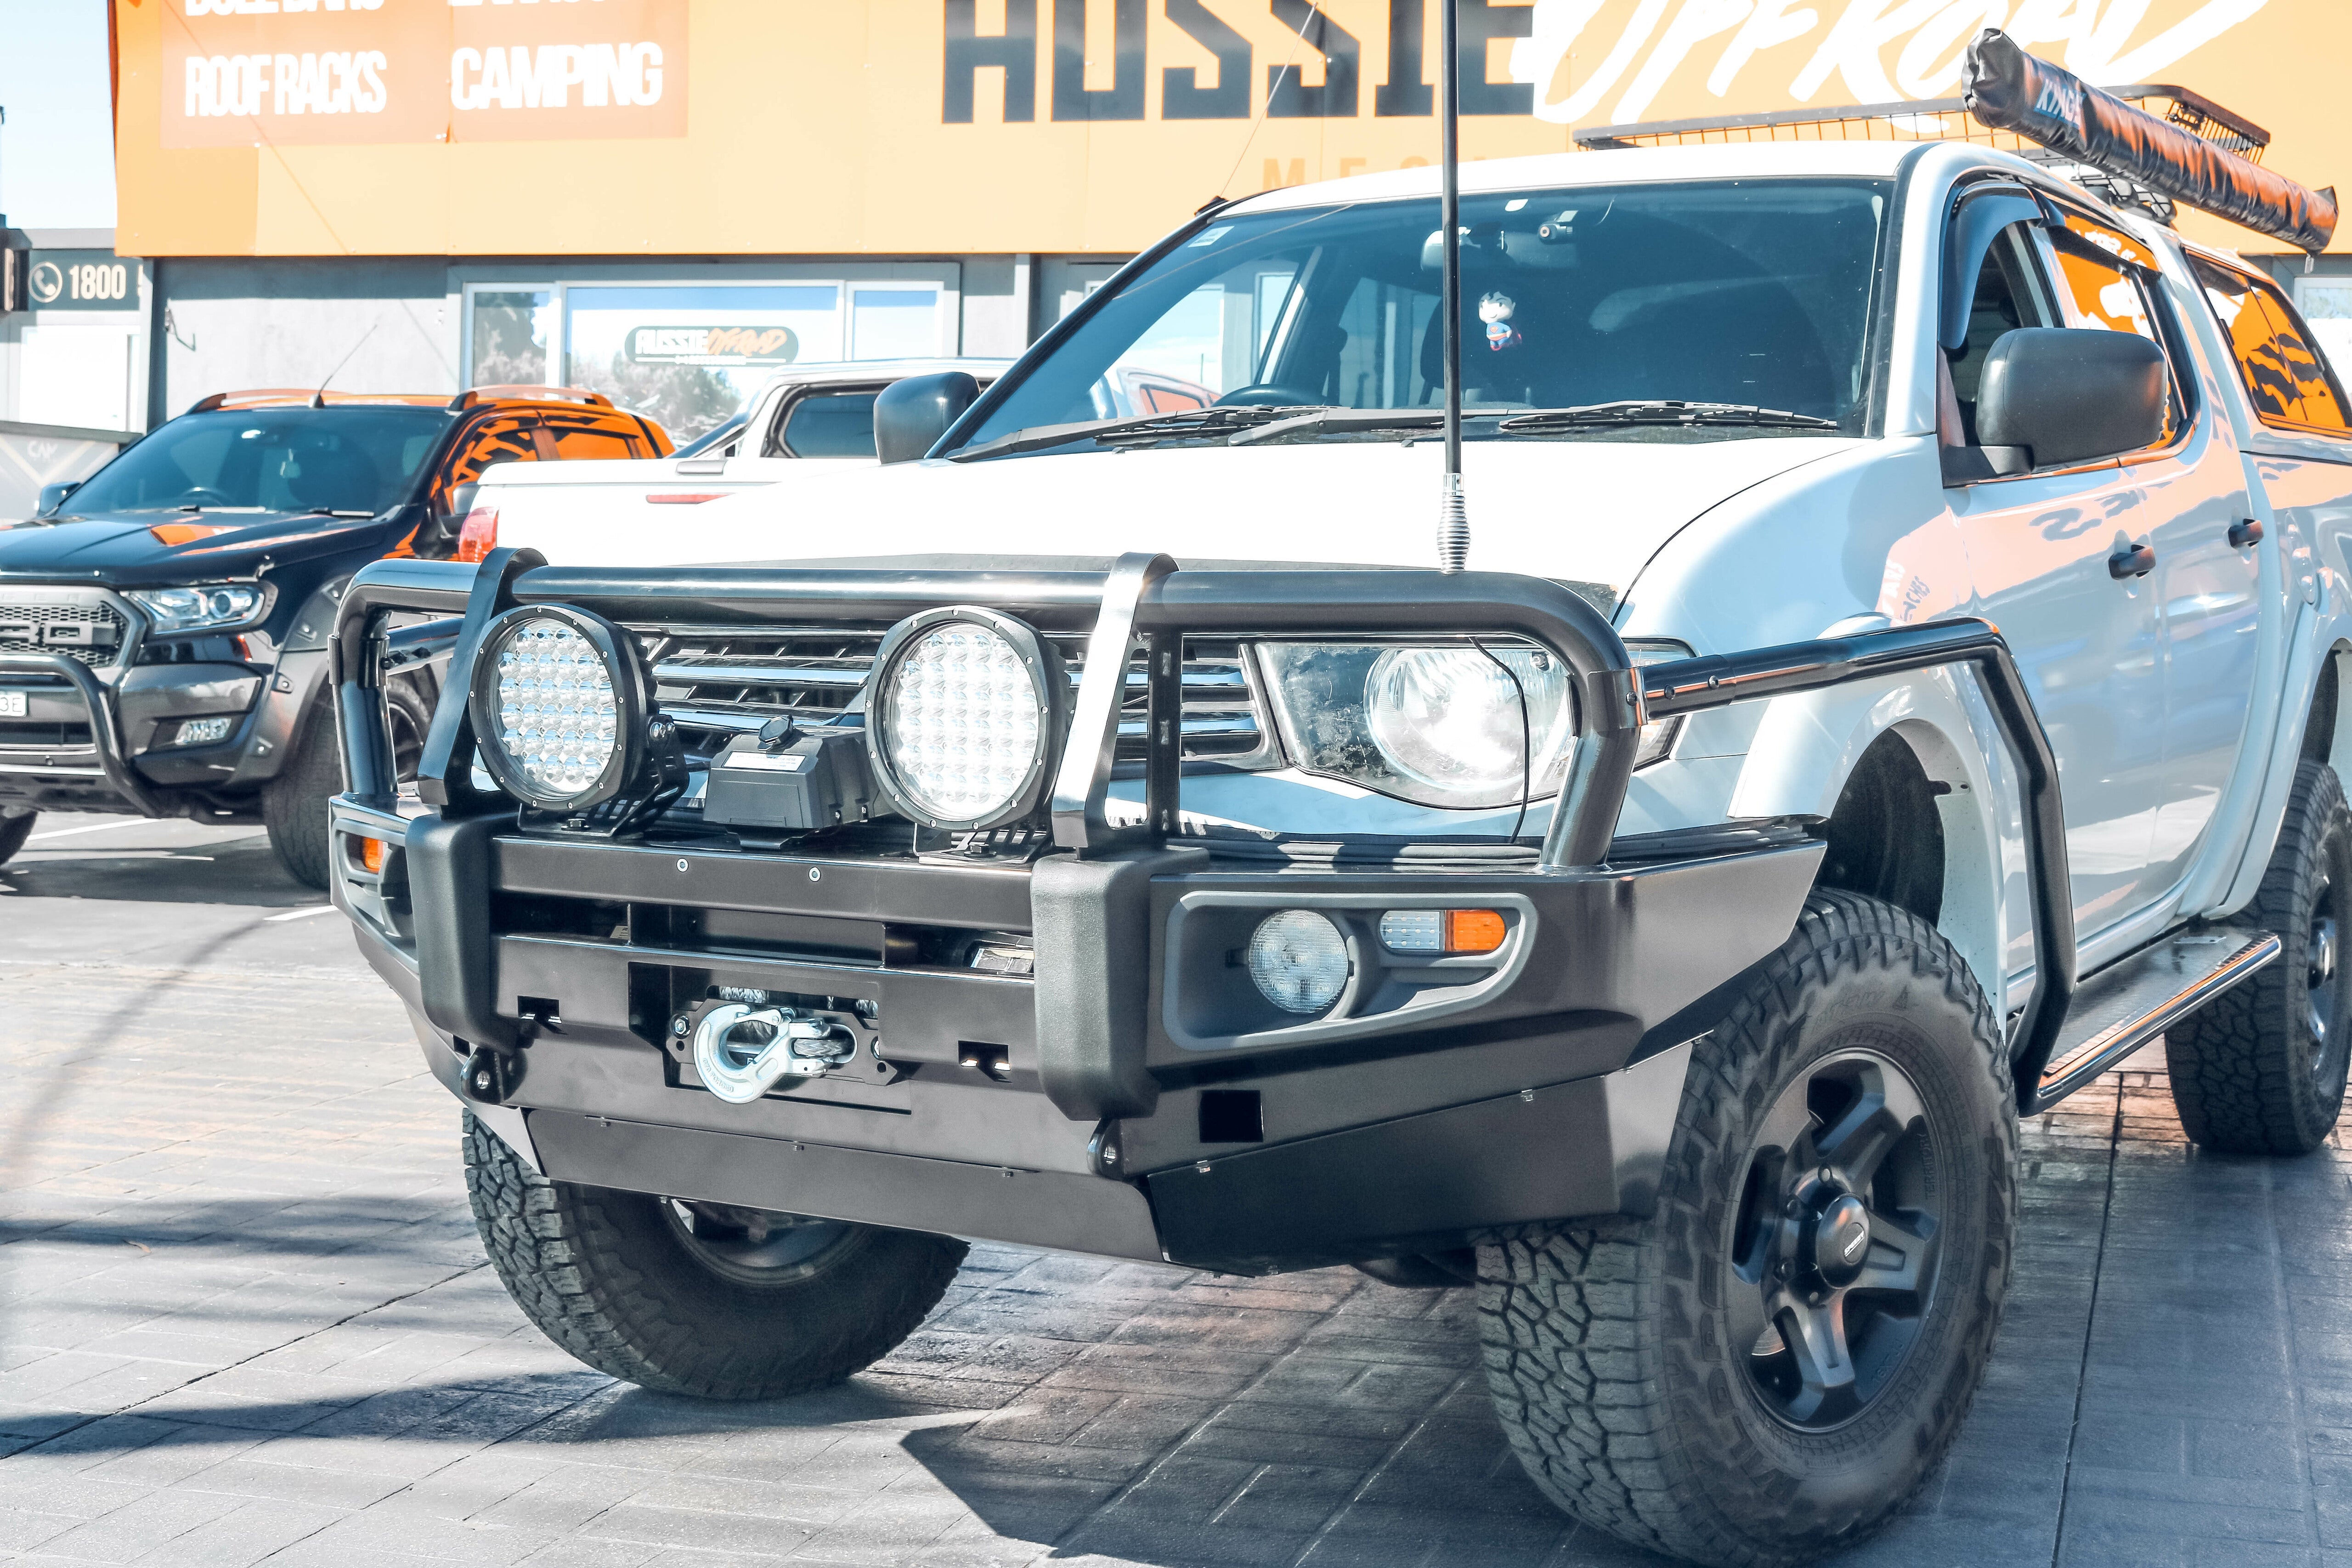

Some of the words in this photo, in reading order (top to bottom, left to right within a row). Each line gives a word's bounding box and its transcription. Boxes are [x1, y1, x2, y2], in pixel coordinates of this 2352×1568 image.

[186, 55, 271, 116] ROOF
[274, 51, 387, 114] RACKS
[451, 41, 663, 110] CAMPING
[69, 264, 126, 300] 1800
[635, 329, 708, 354] AUSSIE
